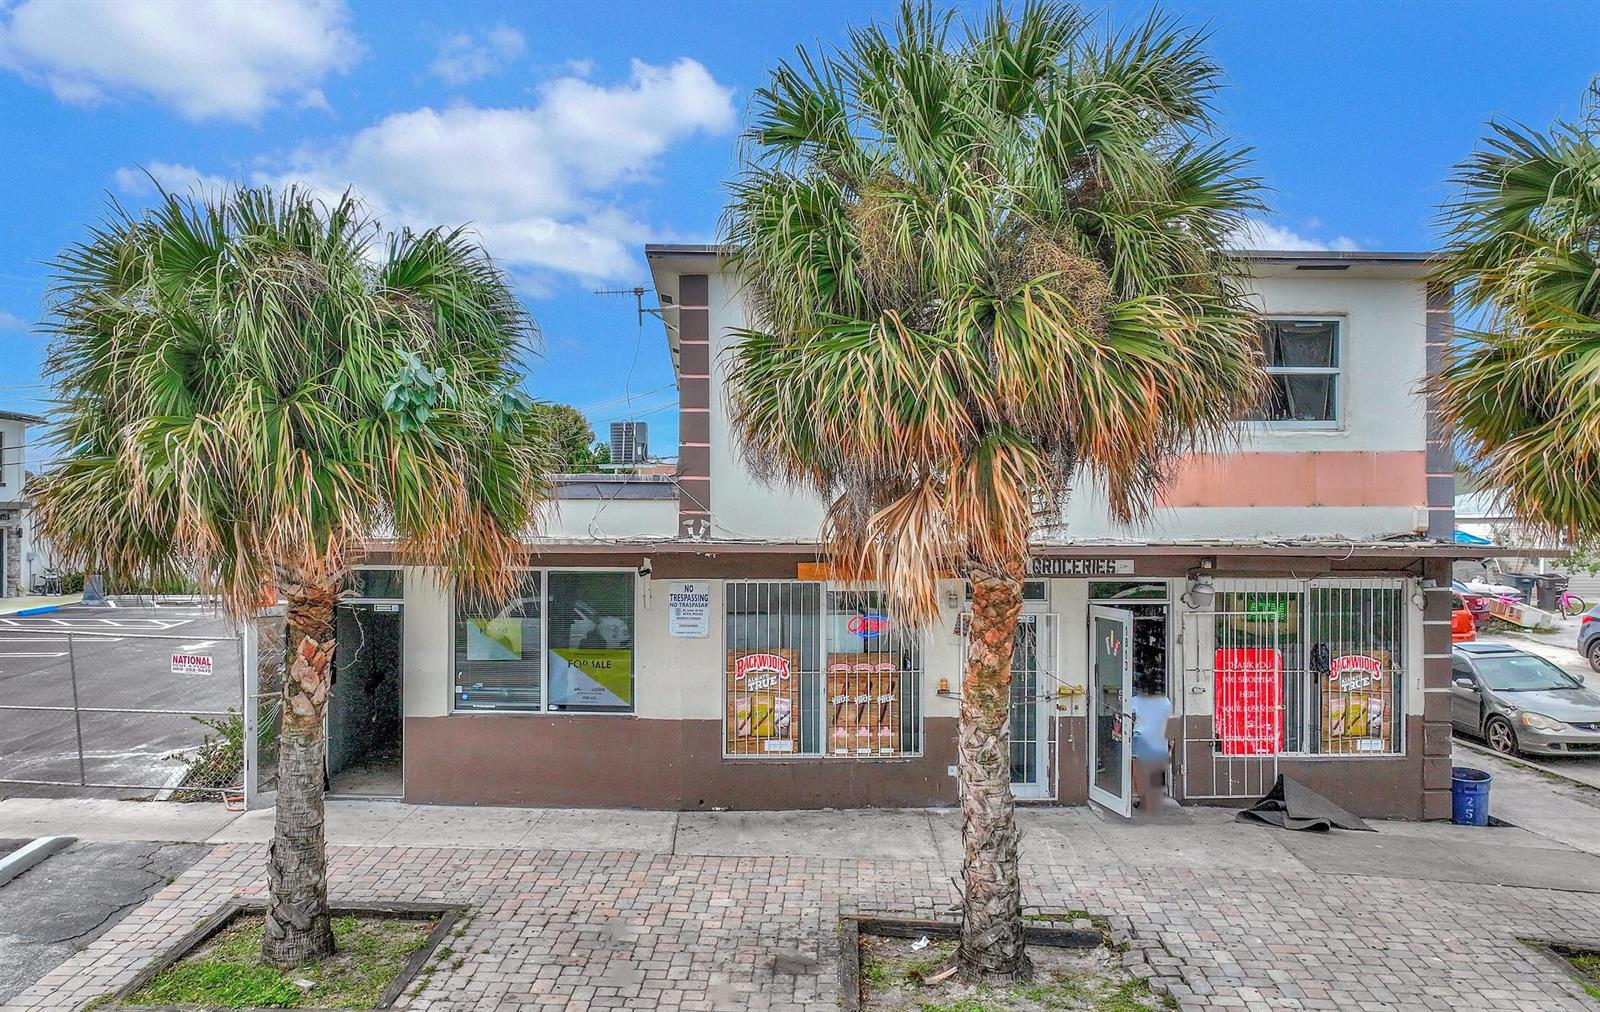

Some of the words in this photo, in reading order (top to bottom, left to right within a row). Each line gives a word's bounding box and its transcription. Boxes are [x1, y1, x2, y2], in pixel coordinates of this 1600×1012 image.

[1033, 559, 1116, 574] GROCERIES
[684, 584, 694, 593] NO
[669, 593, 709, 602] TRESPASSING
[172, 655, 212, 666] NATIONAL
[591, 660, 612, 669] SALE
[736, 654, 790, 679] BACKWOODS
[1329, 655, 1382, 680] BACKWOODS
[748, 676, 778, 691] TRUE
[1342, 677, 1370, 692] TRUE
